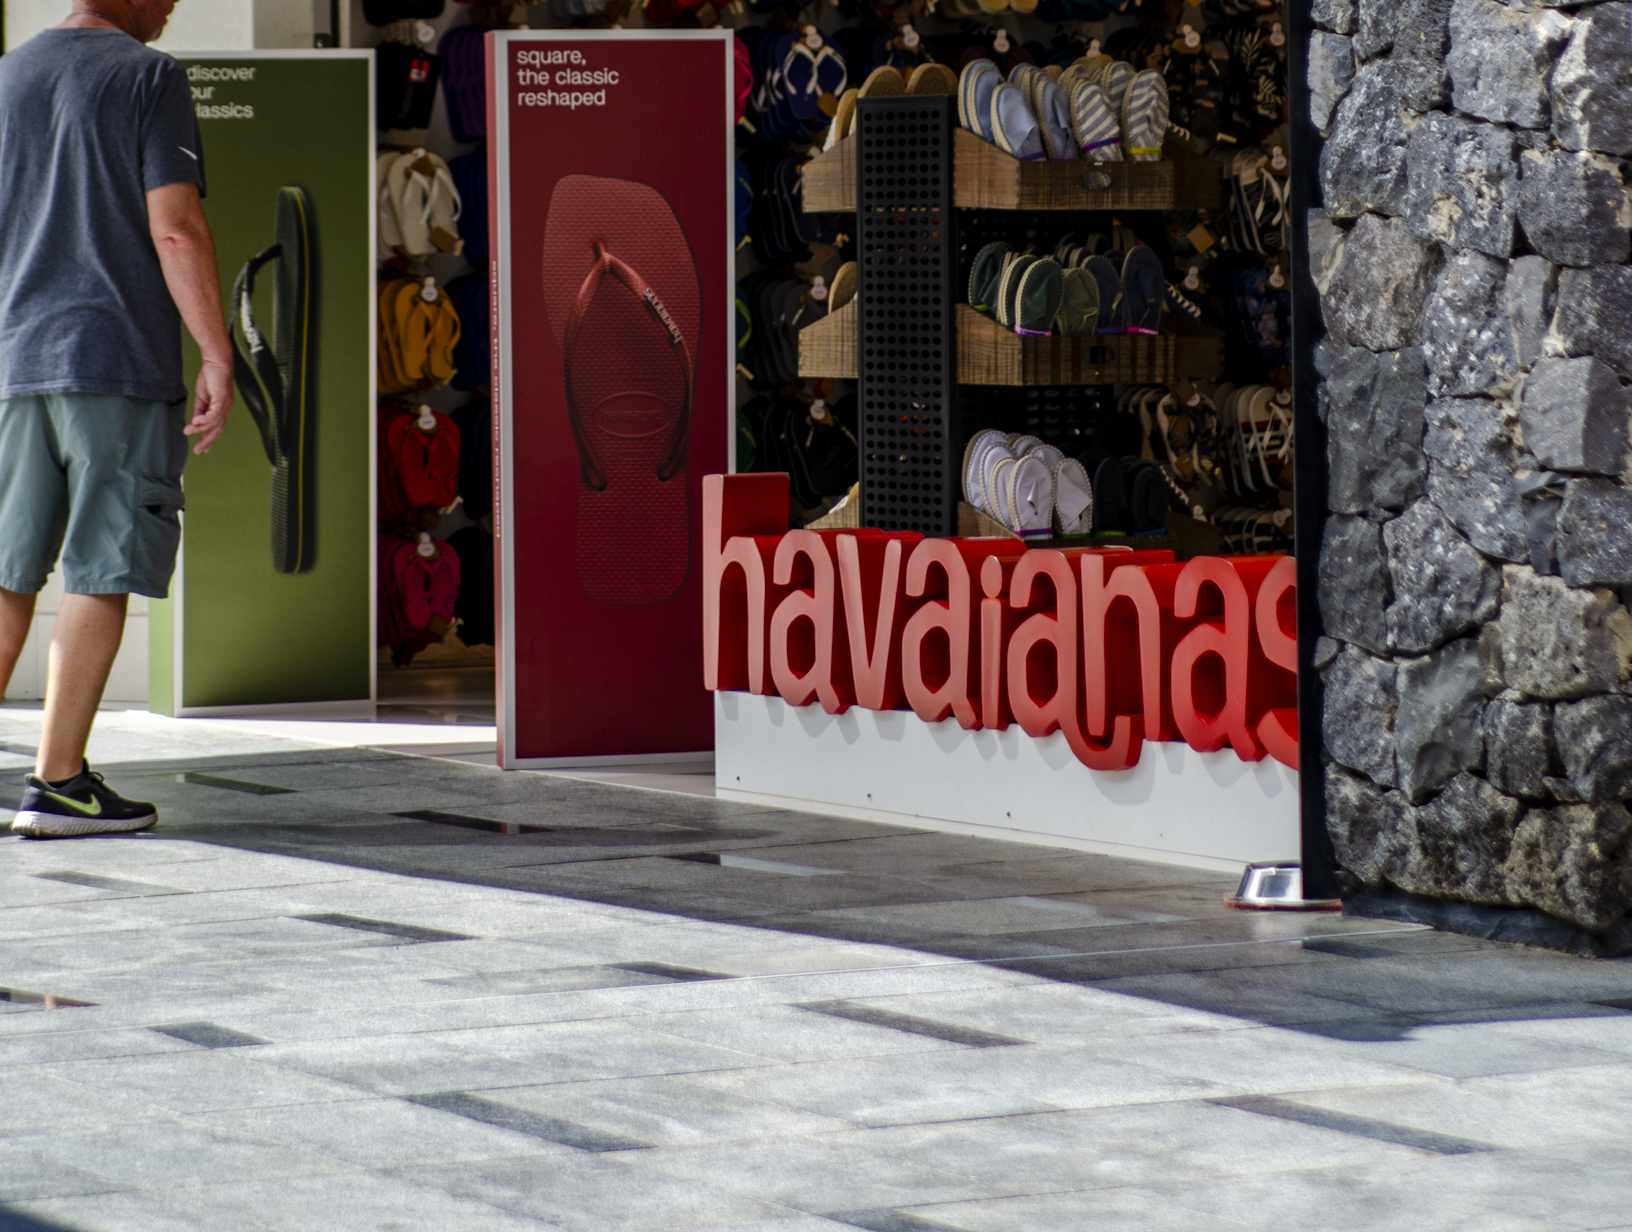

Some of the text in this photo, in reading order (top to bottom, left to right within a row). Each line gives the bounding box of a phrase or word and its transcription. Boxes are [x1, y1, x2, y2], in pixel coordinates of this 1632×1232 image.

[517, 50, 586, 68] square,
[186, 65, 256, 80] discover
[517, 68, 619, 85] the classic
[518, 89, 606, 109] reshaped
[195, 102, 254, 119] lassics
